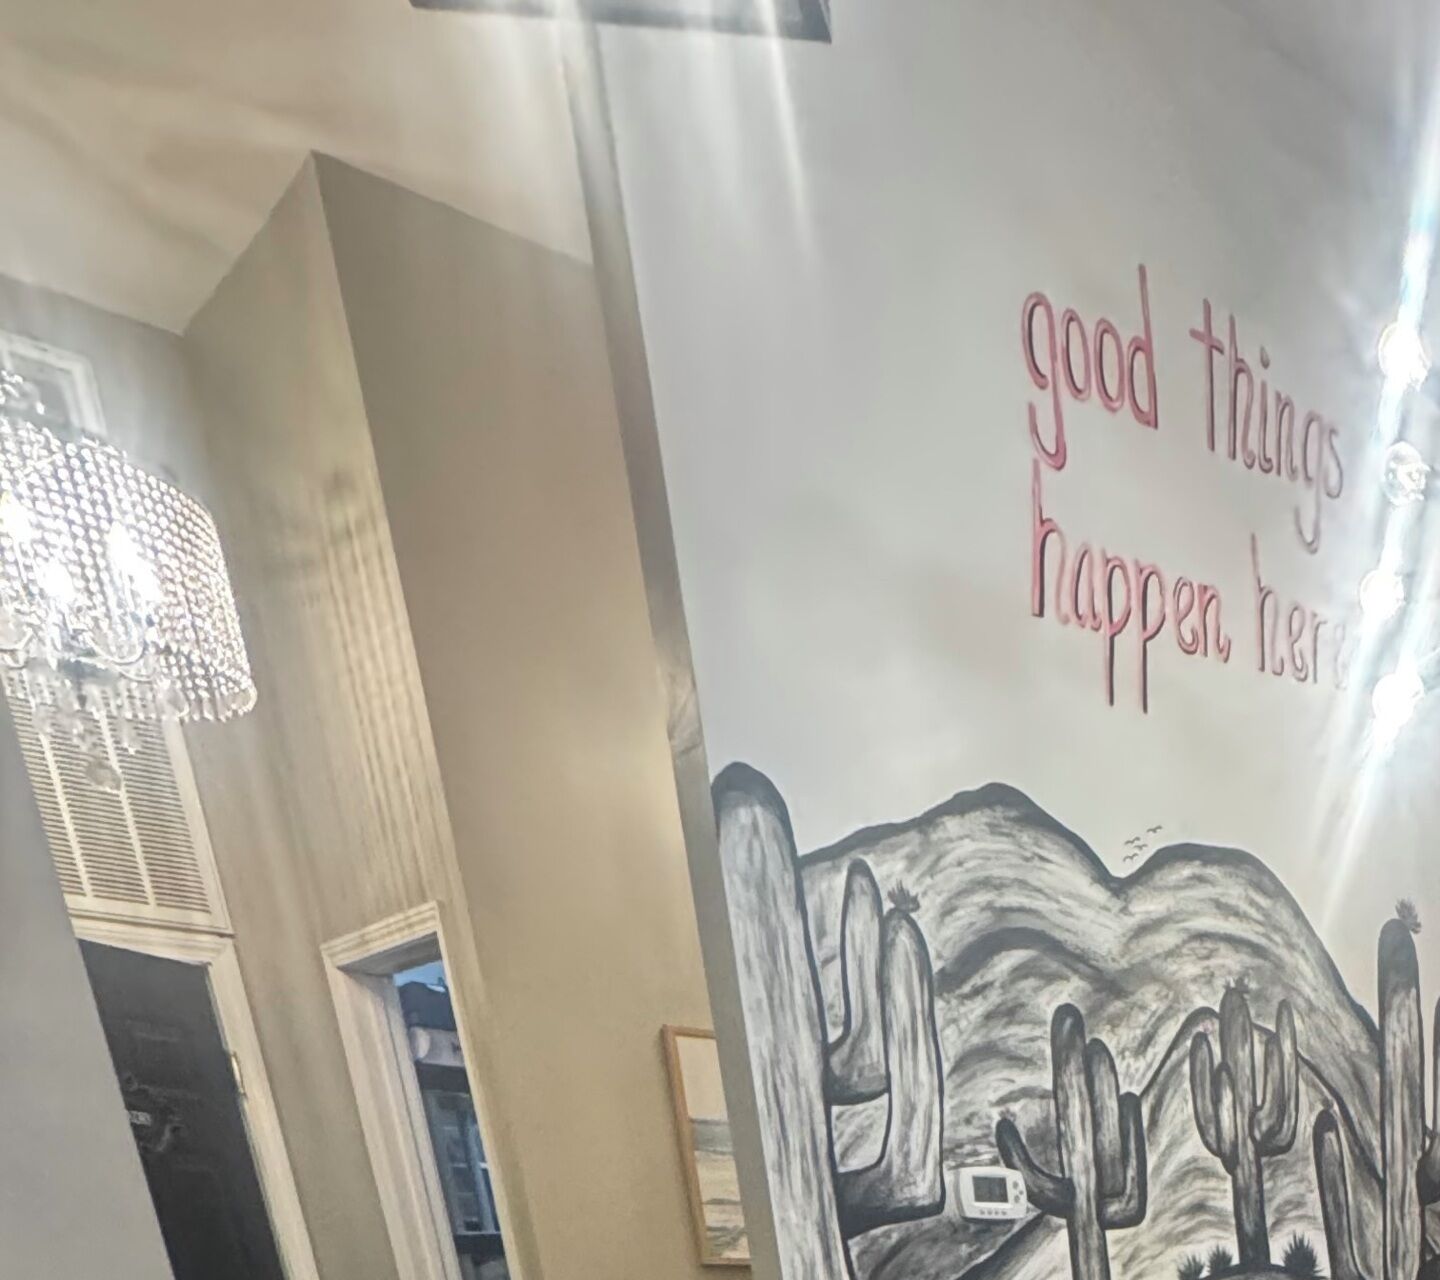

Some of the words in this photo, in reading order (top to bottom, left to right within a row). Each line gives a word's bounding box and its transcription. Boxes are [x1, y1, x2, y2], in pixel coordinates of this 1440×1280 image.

[1022, 263, 1158, 472] good
[1190, 297, 1343, 555] things
[1031, 458, 1231, 714] happen
